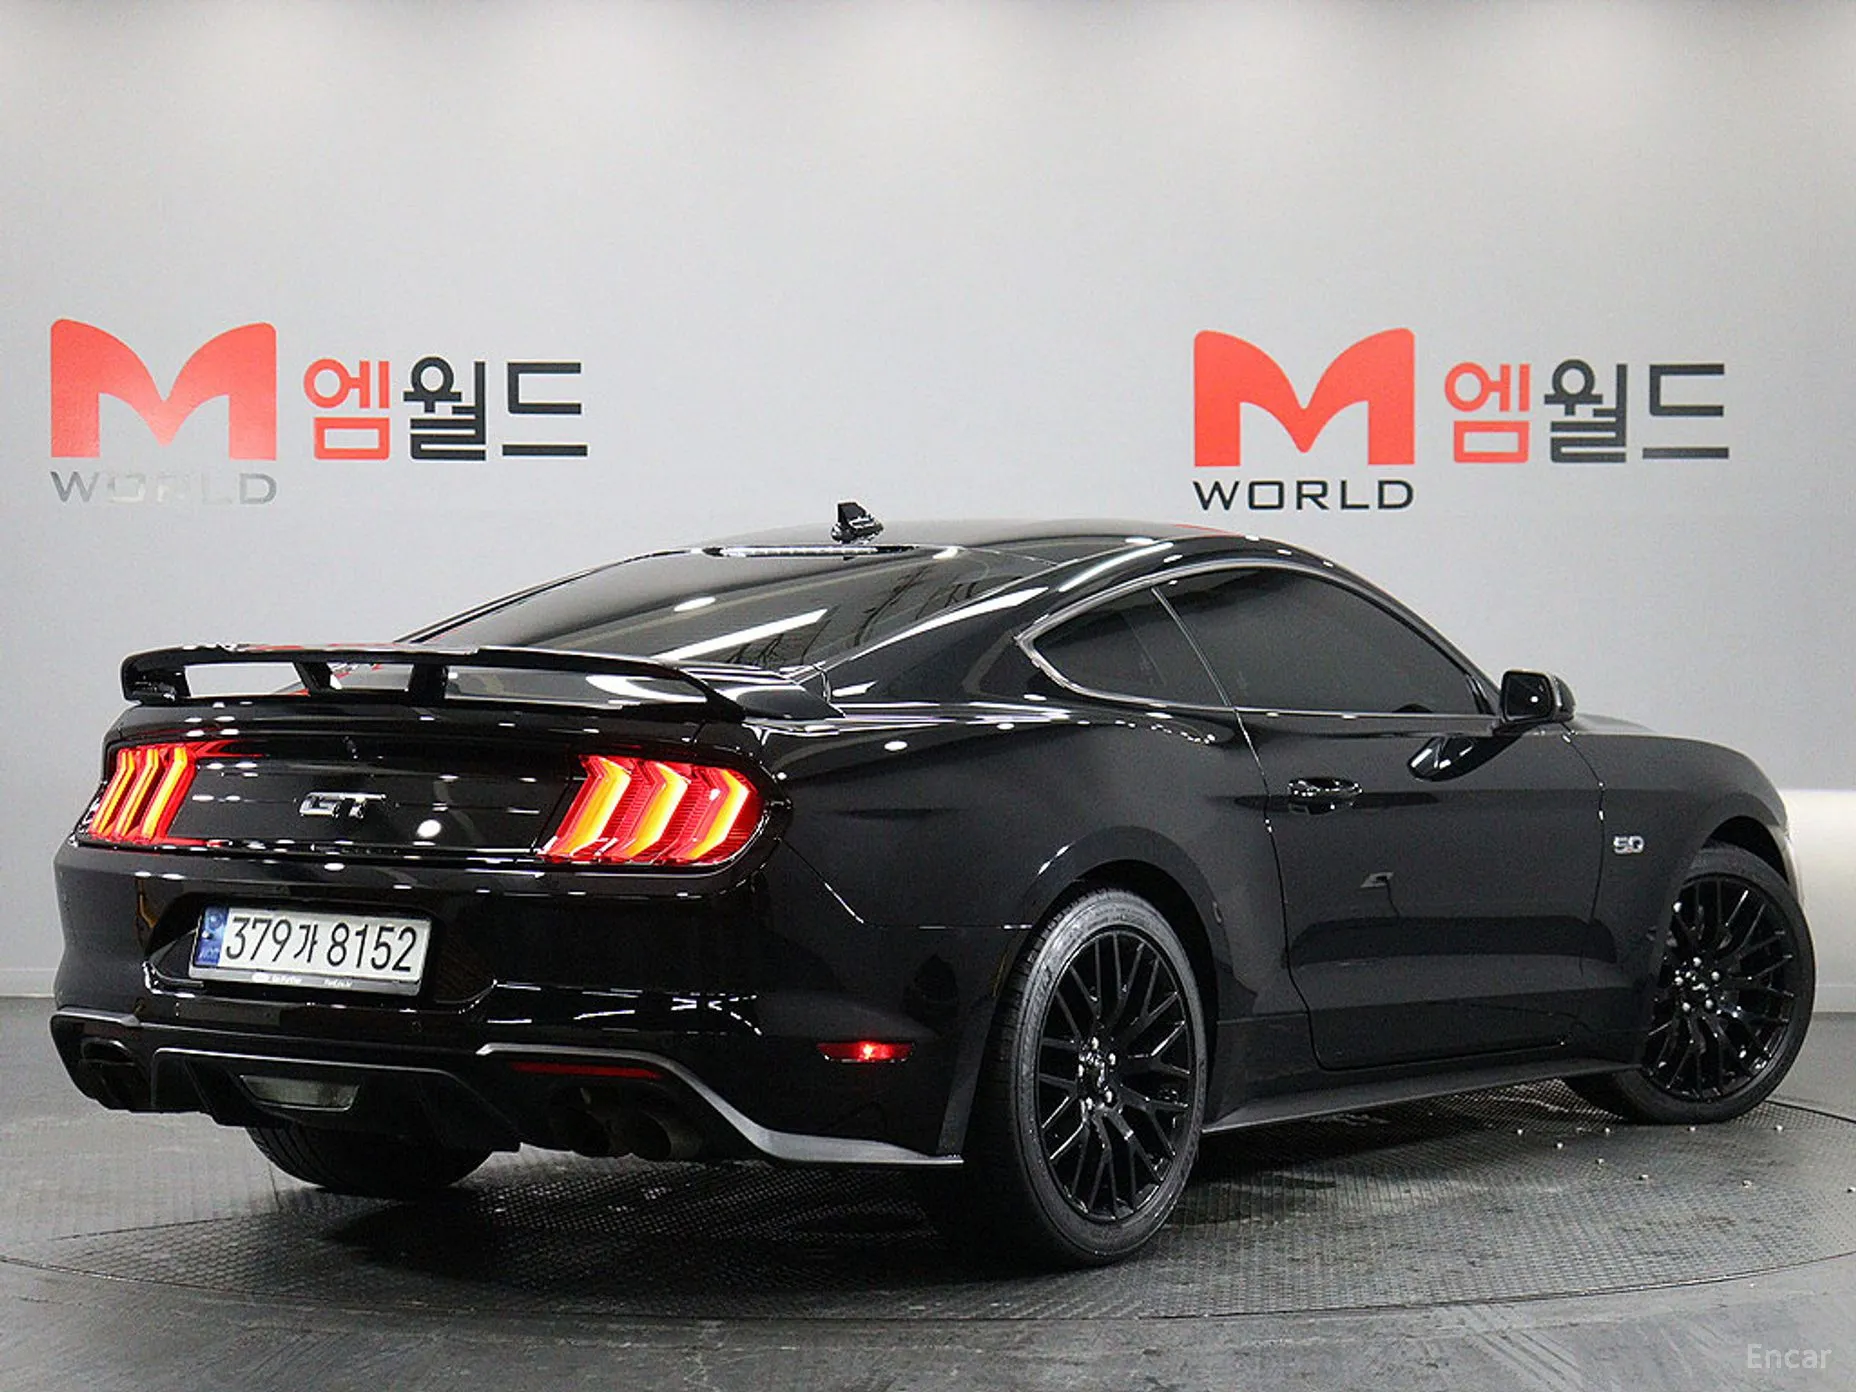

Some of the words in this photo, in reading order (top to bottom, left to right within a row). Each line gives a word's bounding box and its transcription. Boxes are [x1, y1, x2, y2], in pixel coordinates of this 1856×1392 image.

[51, 318, 276, 460] M
[303, 356, 588, 461] 엠월드
[1194, 327, 1415, 467] M
[1444, 359, 1730, 464] 엠월드
[1193, 480, 1414, 510] WORLD
[299, 792, 386, 819] GT
[326, 922, 417, 973] 8152
